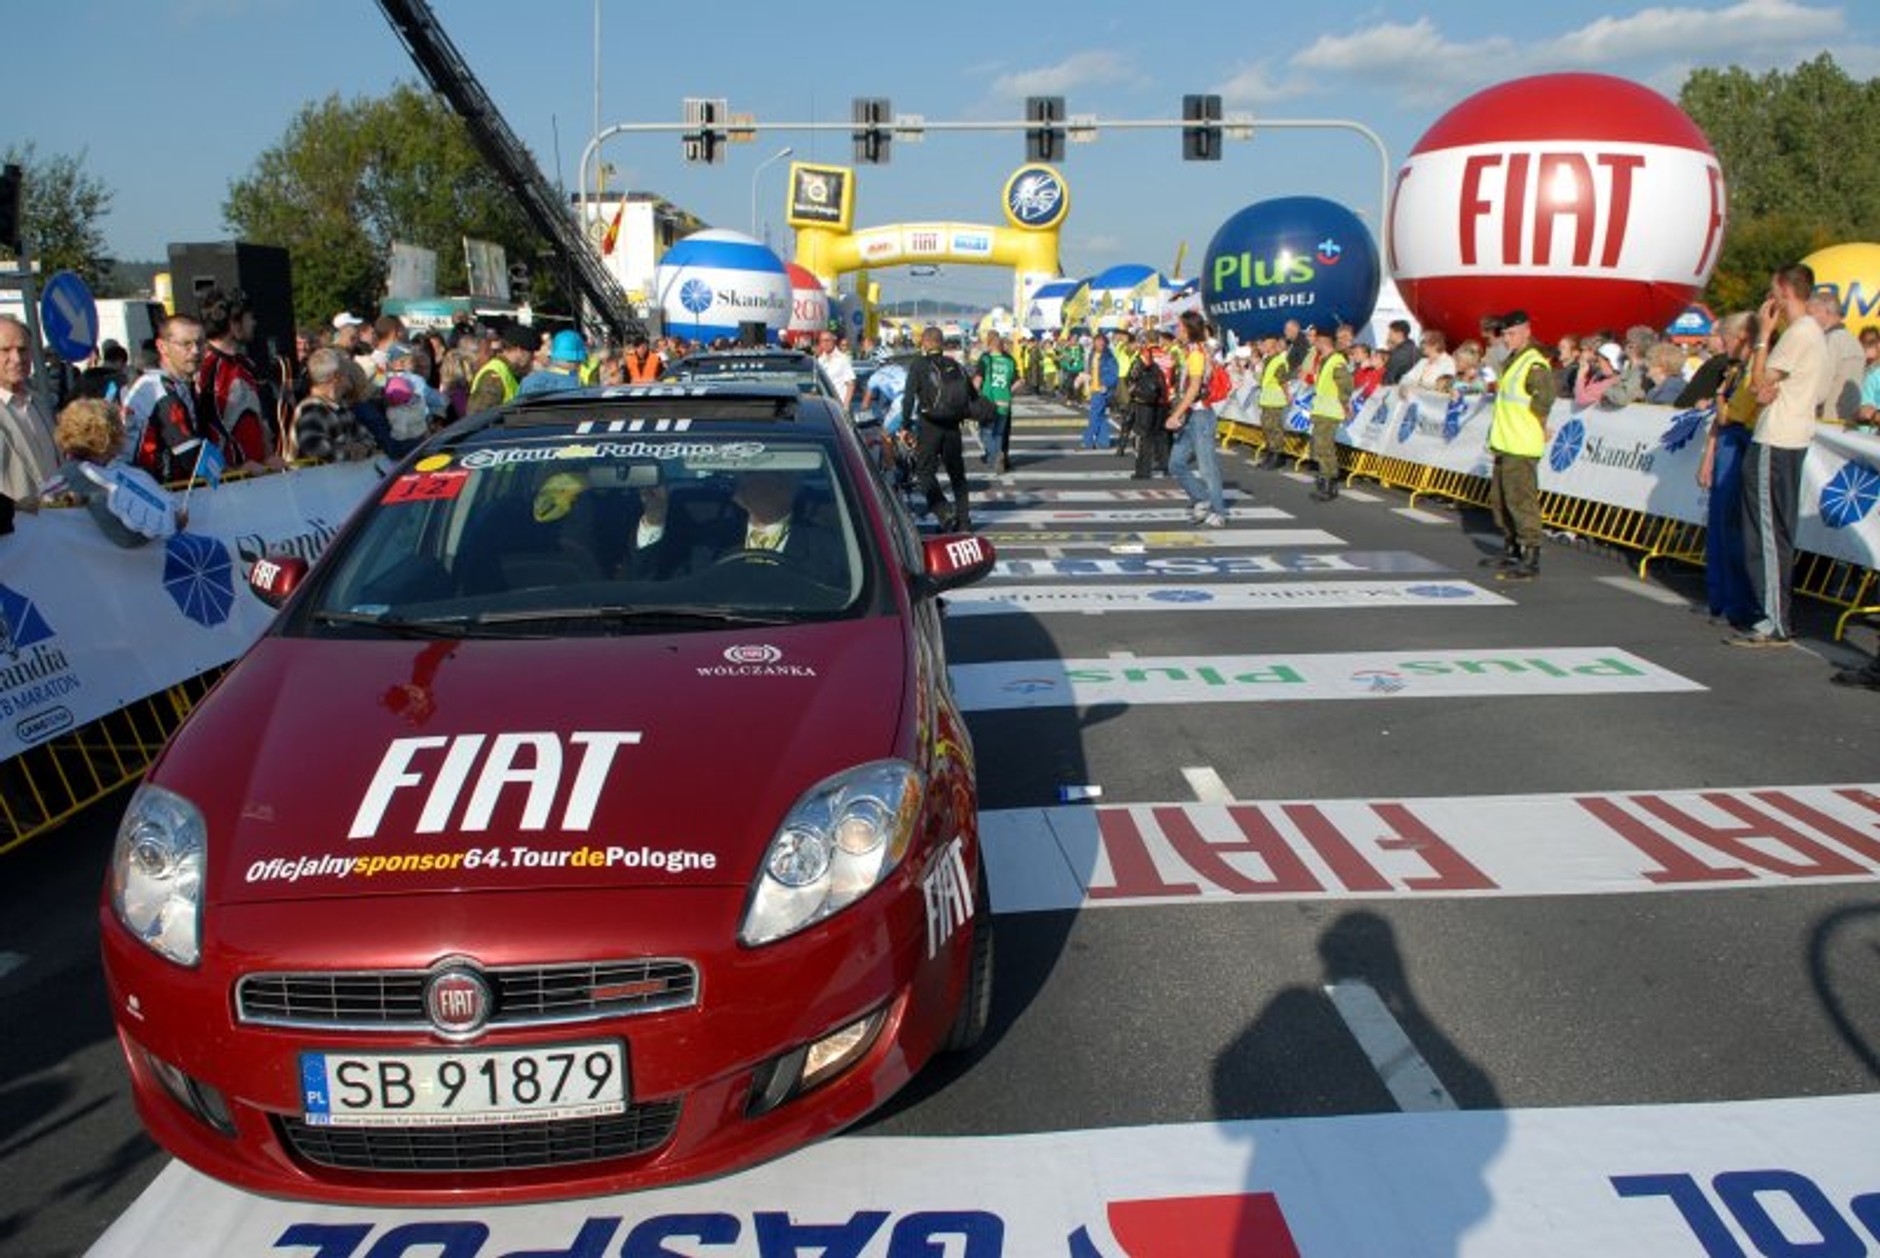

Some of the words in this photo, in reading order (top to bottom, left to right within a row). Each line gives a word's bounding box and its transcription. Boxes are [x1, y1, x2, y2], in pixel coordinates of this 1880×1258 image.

[1458, 151, 1646, 268] FIAT
[1214, 250, 1315, 293] Plus
[1259, 291, 1315, 310] LEPIEJ
[946, 537, 984, 569] FIAT
[251, 559, 281, 591] FIAT
[1065, 664, 1307, 686] Plus
[1398, 658, 1648, 680] Plus
[347, 731, 643, 839] FIAT
[1088, 804, 1500, 899] FIAT
[923, 835, 974, 960] FIAT
[440, 989, 474, 1016] FIAT
[336, 1060, 416, 1109] SB
[438, 1050, 614, 1108] 91879
[308, 1090, 326, 1104] PL
